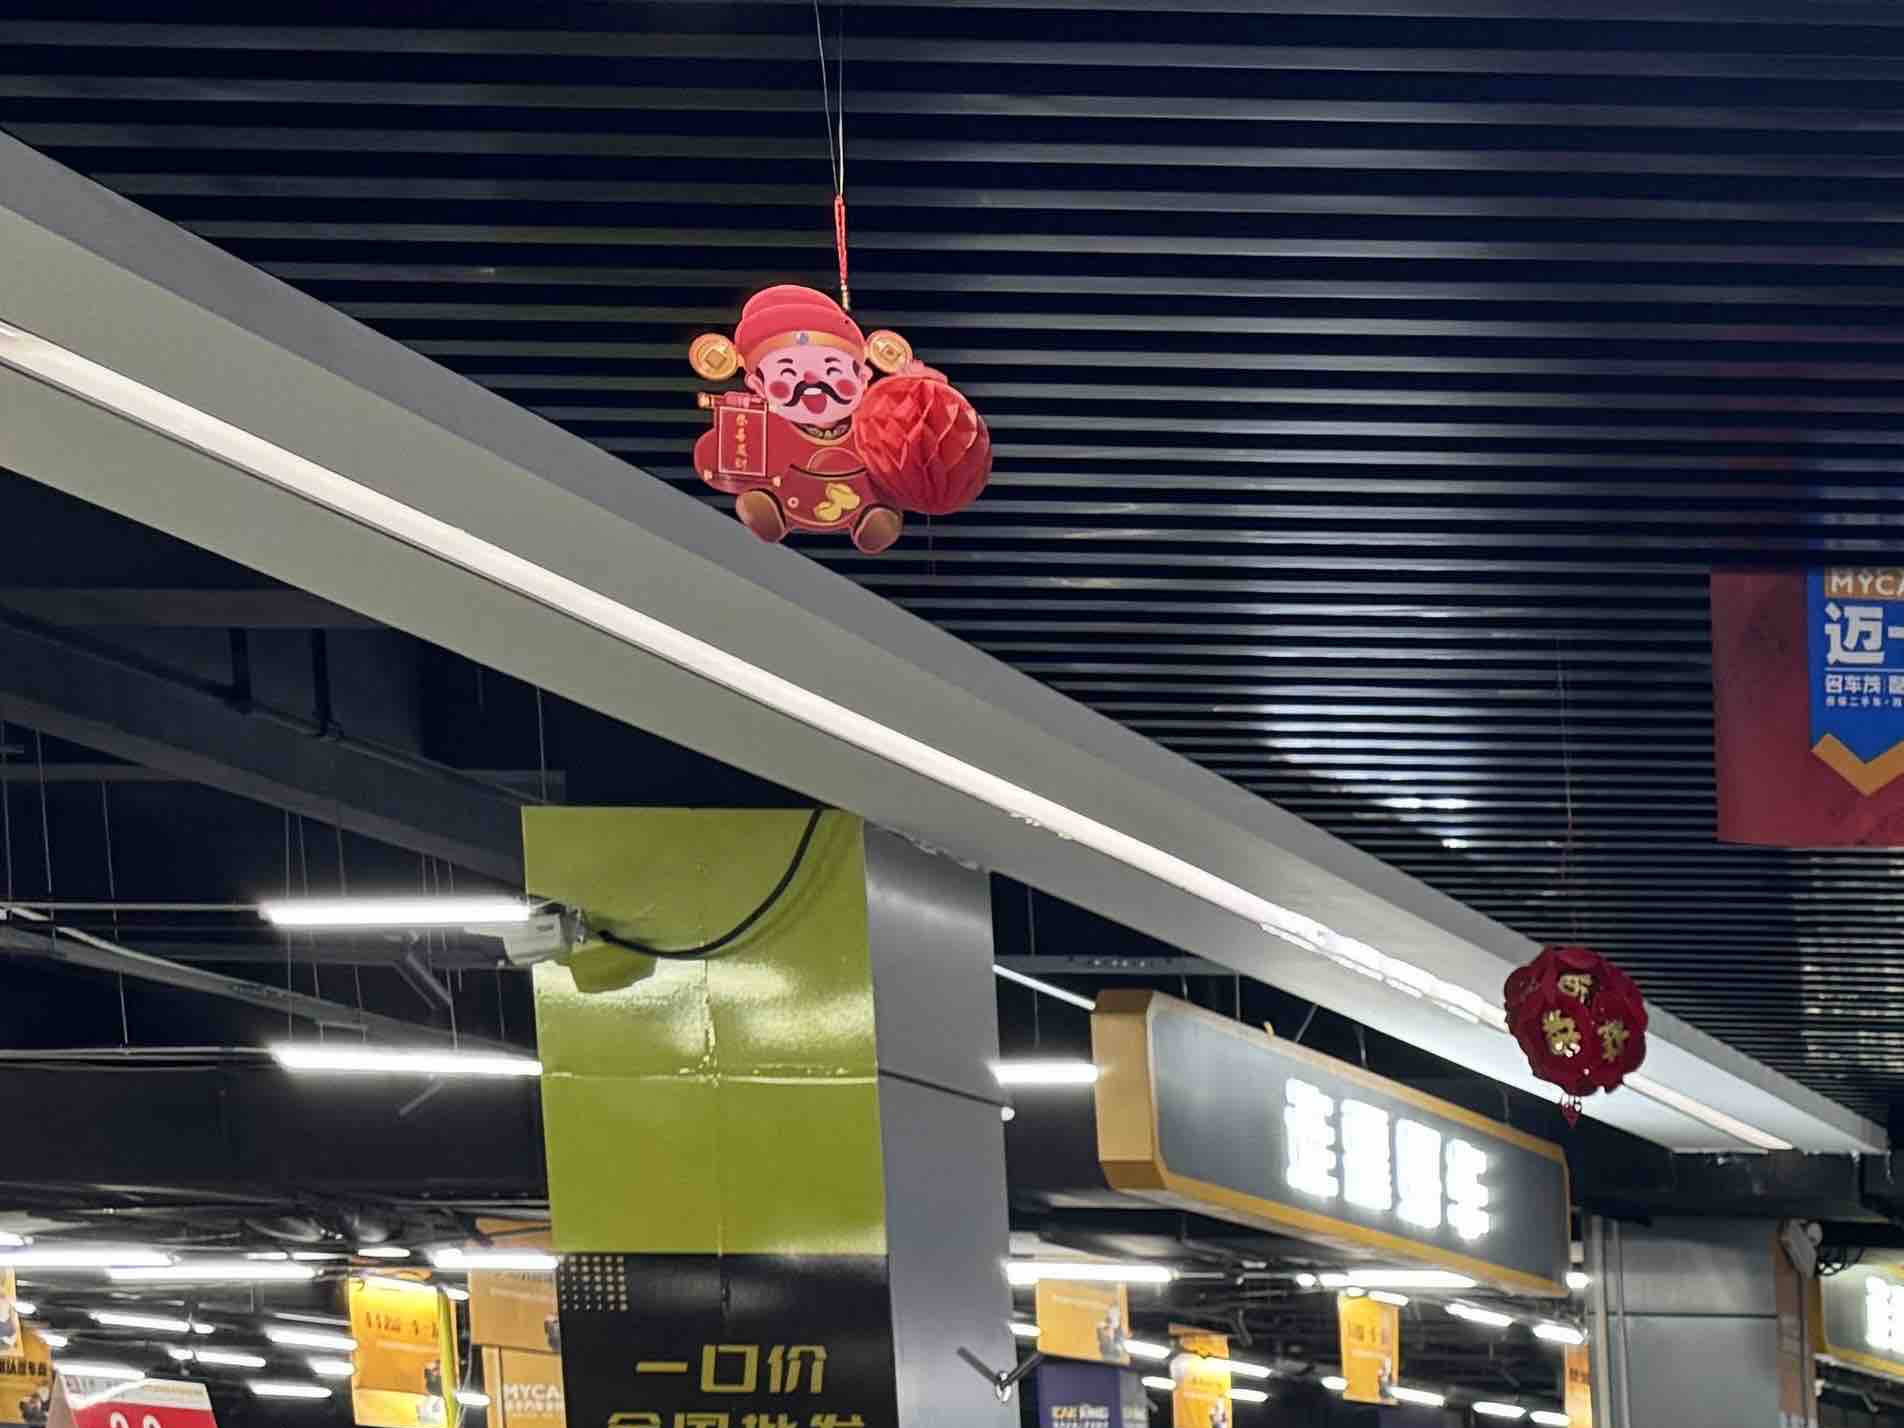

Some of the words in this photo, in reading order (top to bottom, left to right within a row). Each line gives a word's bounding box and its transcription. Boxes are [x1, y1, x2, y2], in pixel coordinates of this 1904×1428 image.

[635, 1343, 828, 1394] 一口价
[504, 1384, 562, 1400] MYCA
